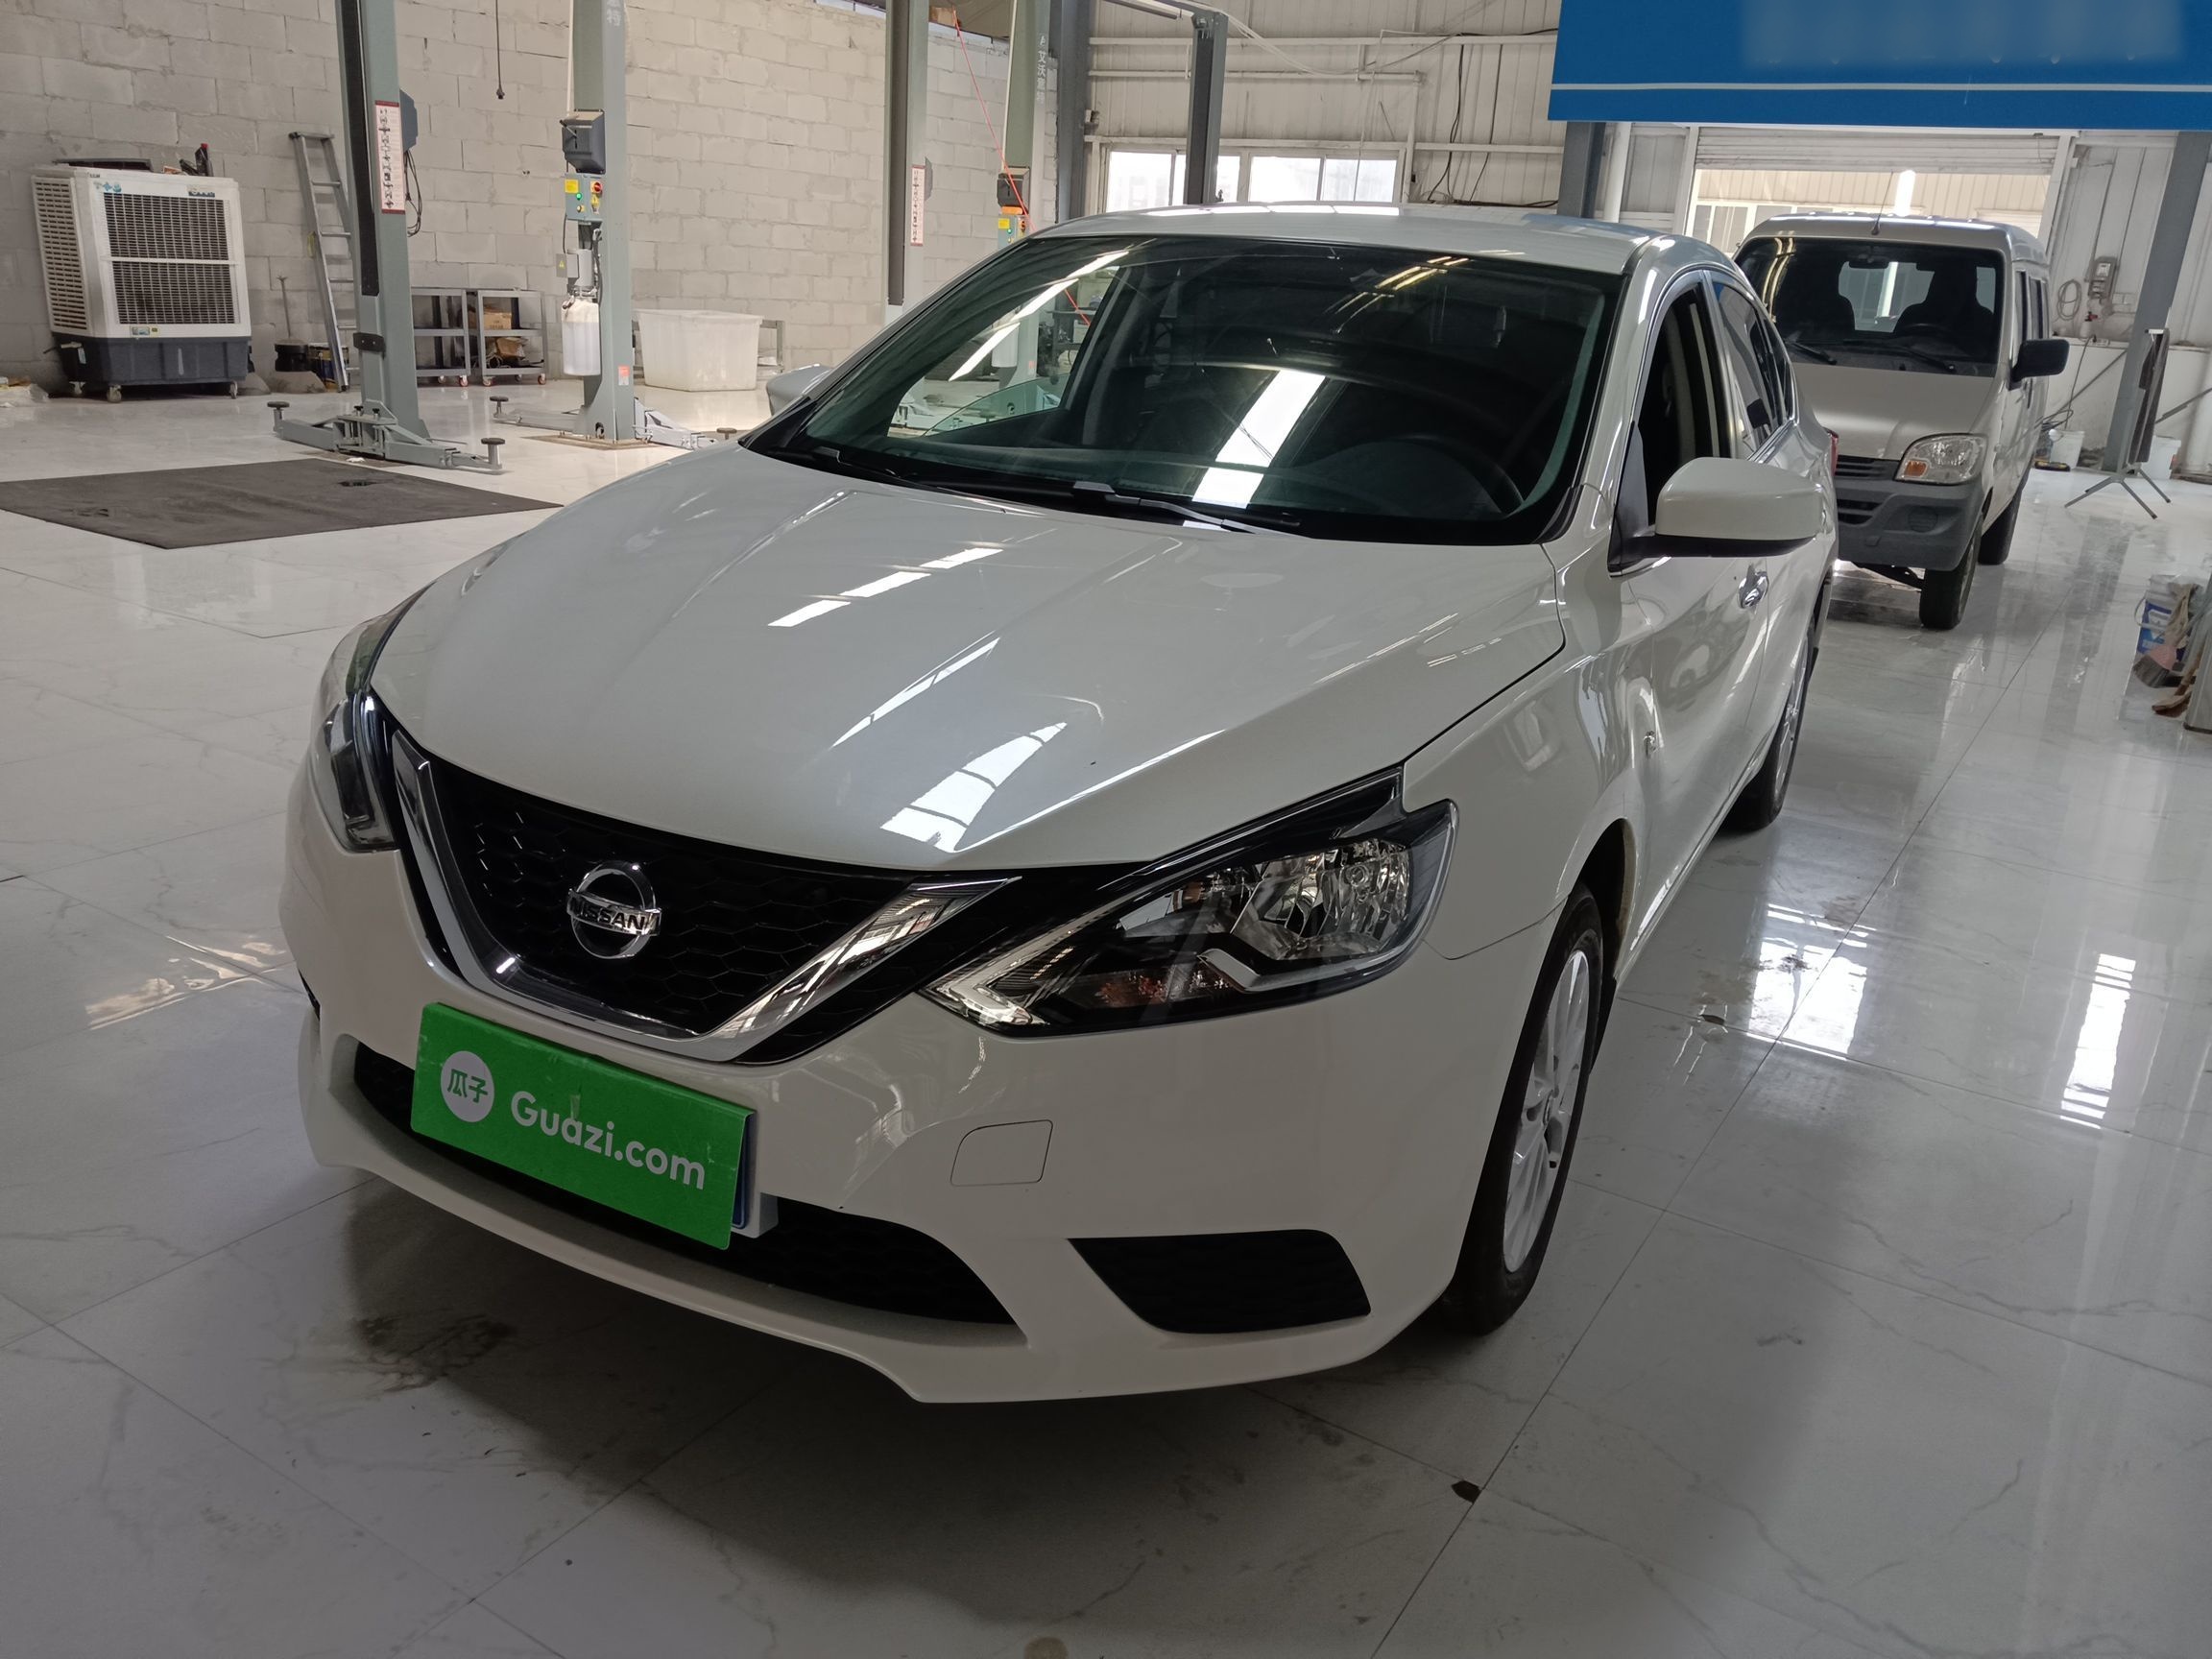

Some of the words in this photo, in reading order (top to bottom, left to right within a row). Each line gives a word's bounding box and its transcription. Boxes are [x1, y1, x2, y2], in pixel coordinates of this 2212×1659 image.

[571, 893, 648, 929] NISSAN
[447, 1069, 488, 1103] 瓜子
[511, 1091, 706, 1190] Guazi.com
